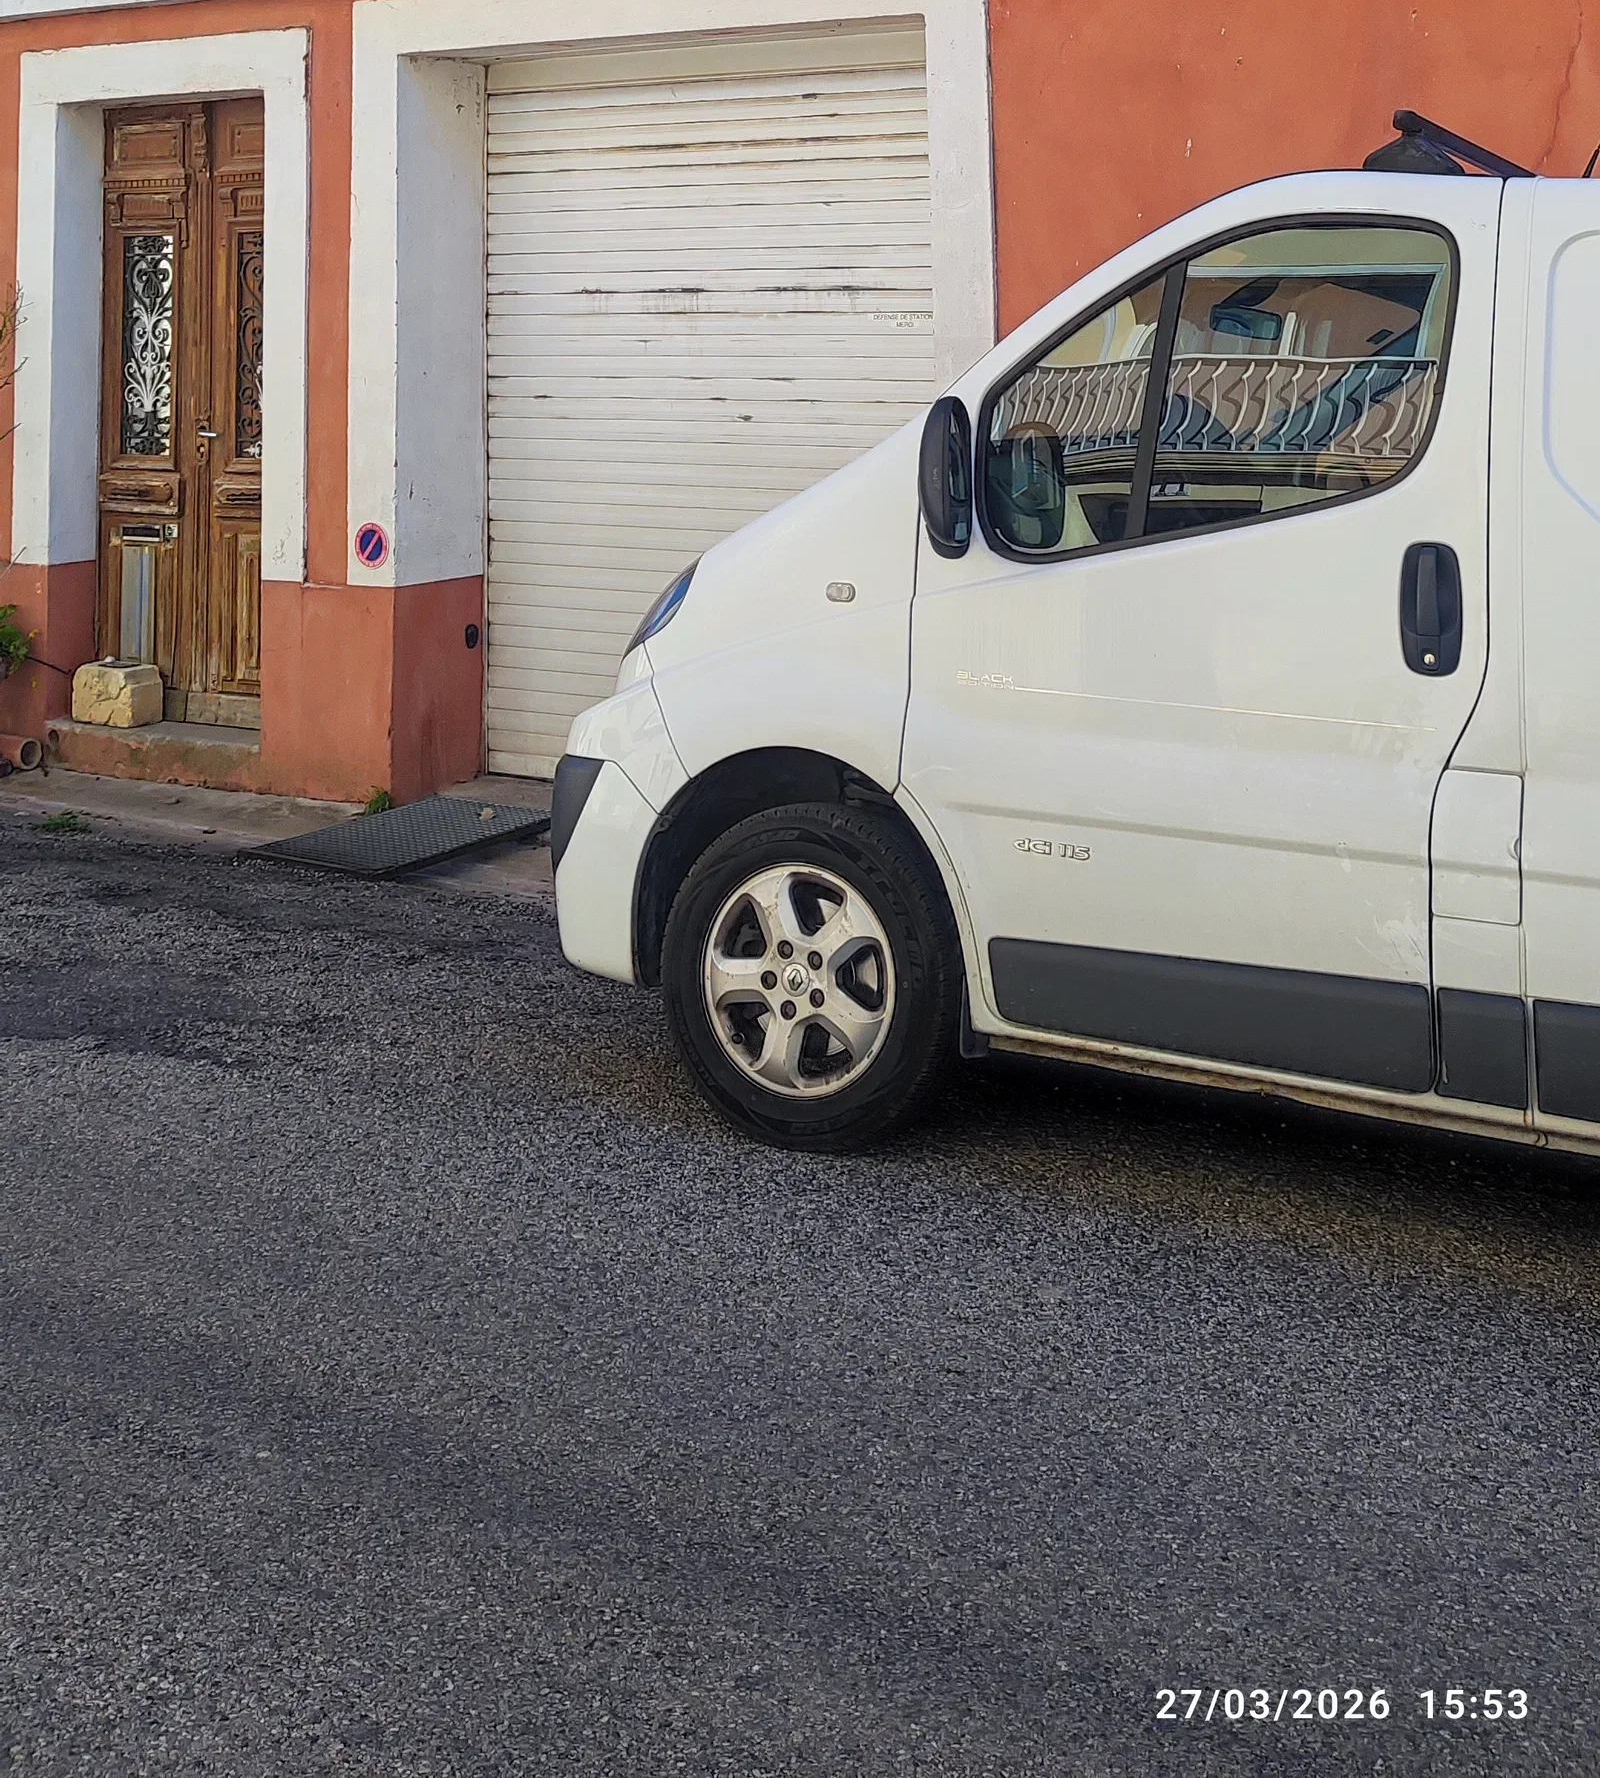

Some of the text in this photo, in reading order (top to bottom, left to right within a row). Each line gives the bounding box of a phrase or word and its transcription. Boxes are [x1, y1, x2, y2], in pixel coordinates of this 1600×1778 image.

[956, 670, 1014, 684] BLACK
[956, 679, 1015, 690] EDITION
[1058, 842, 1091, 861] 115
